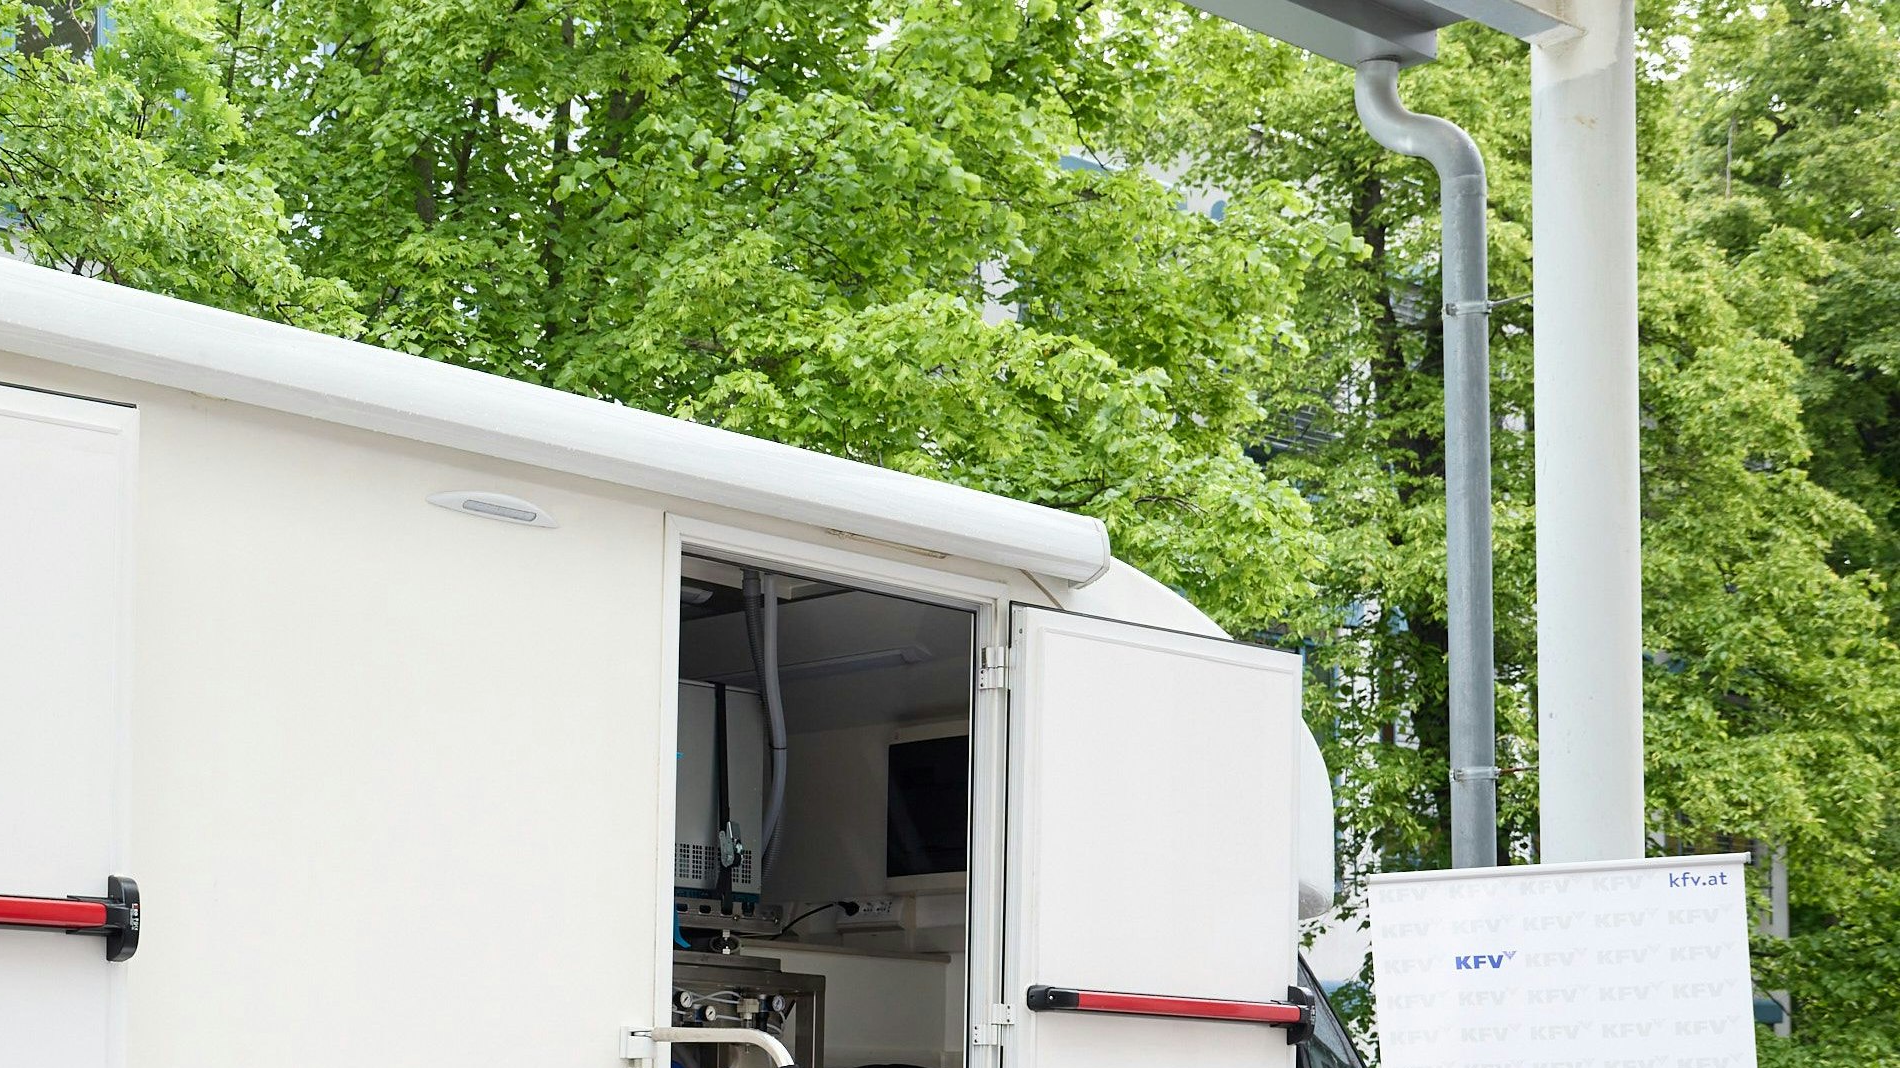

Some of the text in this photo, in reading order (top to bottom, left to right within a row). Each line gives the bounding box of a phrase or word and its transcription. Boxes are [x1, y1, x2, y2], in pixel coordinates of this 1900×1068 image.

[1520, 879, 1569, 894] KFV
[1592, 875, 1641, 891] KFV
[1669, 872, 1728, 888] kfv.at
[1383, 922, 1431, 938] KFV
[1523, 915, 1572, 931] KFV
[1594, 912, 1644, 928] KFV
[1668, 909, 1718, 925] KFV
[1385, 946, 1721, 973] KFV KFV KFV KFV KFV
[1388, 983, 1723, 1009] KFV KFV KFV KFV KFV
[1391, 1020, 1725, 1045] KFV KFV KFV KFV KFV
